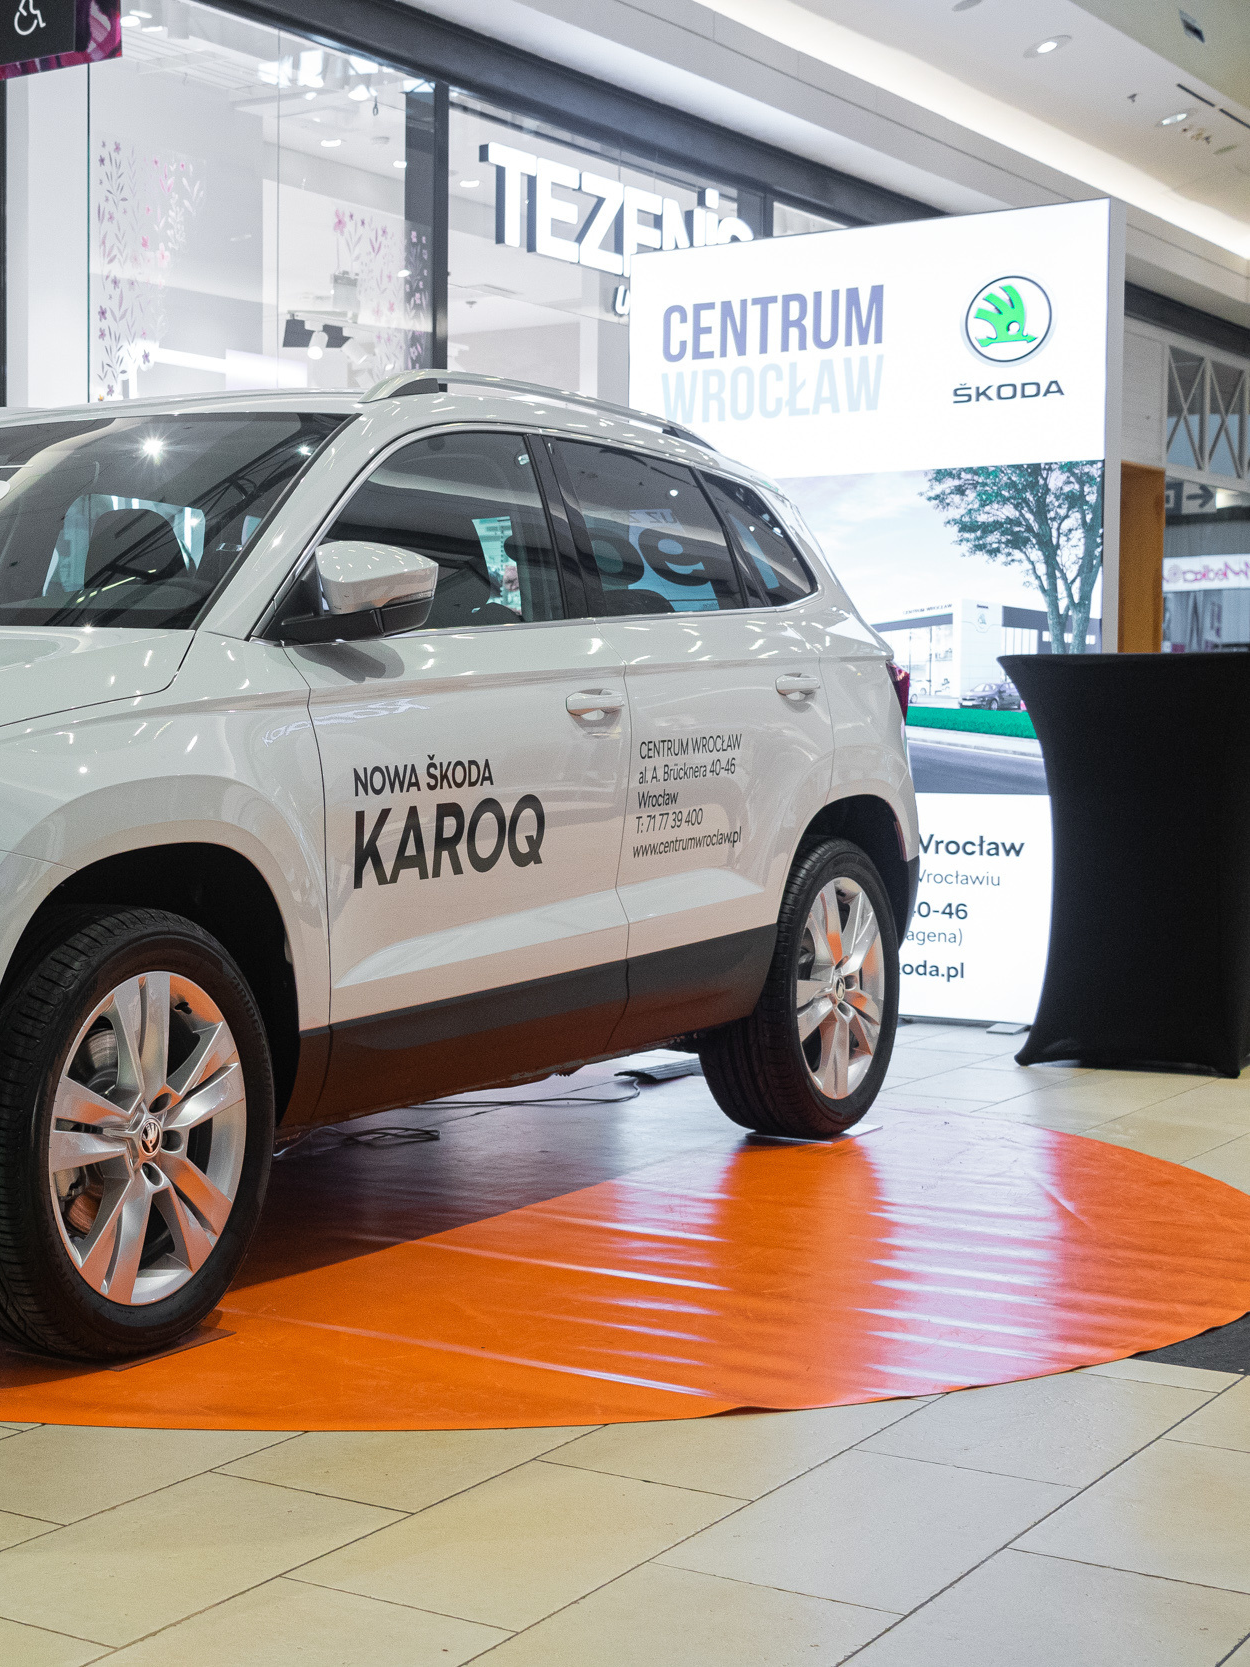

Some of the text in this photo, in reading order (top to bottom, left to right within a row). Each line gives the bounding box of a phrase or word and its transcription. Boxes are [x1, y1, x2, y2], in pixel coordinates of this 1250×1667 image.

[662, 284, 885, 363] CENTRUM
[661, 354, 885, 425] WROCŁAW
[953, 380, 1065, 404] ŠKODA
[639, 734, 742, 759] CENTRUM WROCŁAW
[353, 754, 494, 797] NOWA ŠKODA
[638, 757, 736, 784] al. A. Brücknera 40-46
[637, 789, 679, 809] Wrocław
[636, 808, 704, 834] T: 71 77 39 400
[353, 794, 545, 890] KAROQ
[632, 826, 742, 859] www.centrumwroclaw.pl
[913, 901, 968, 920] 0-46
